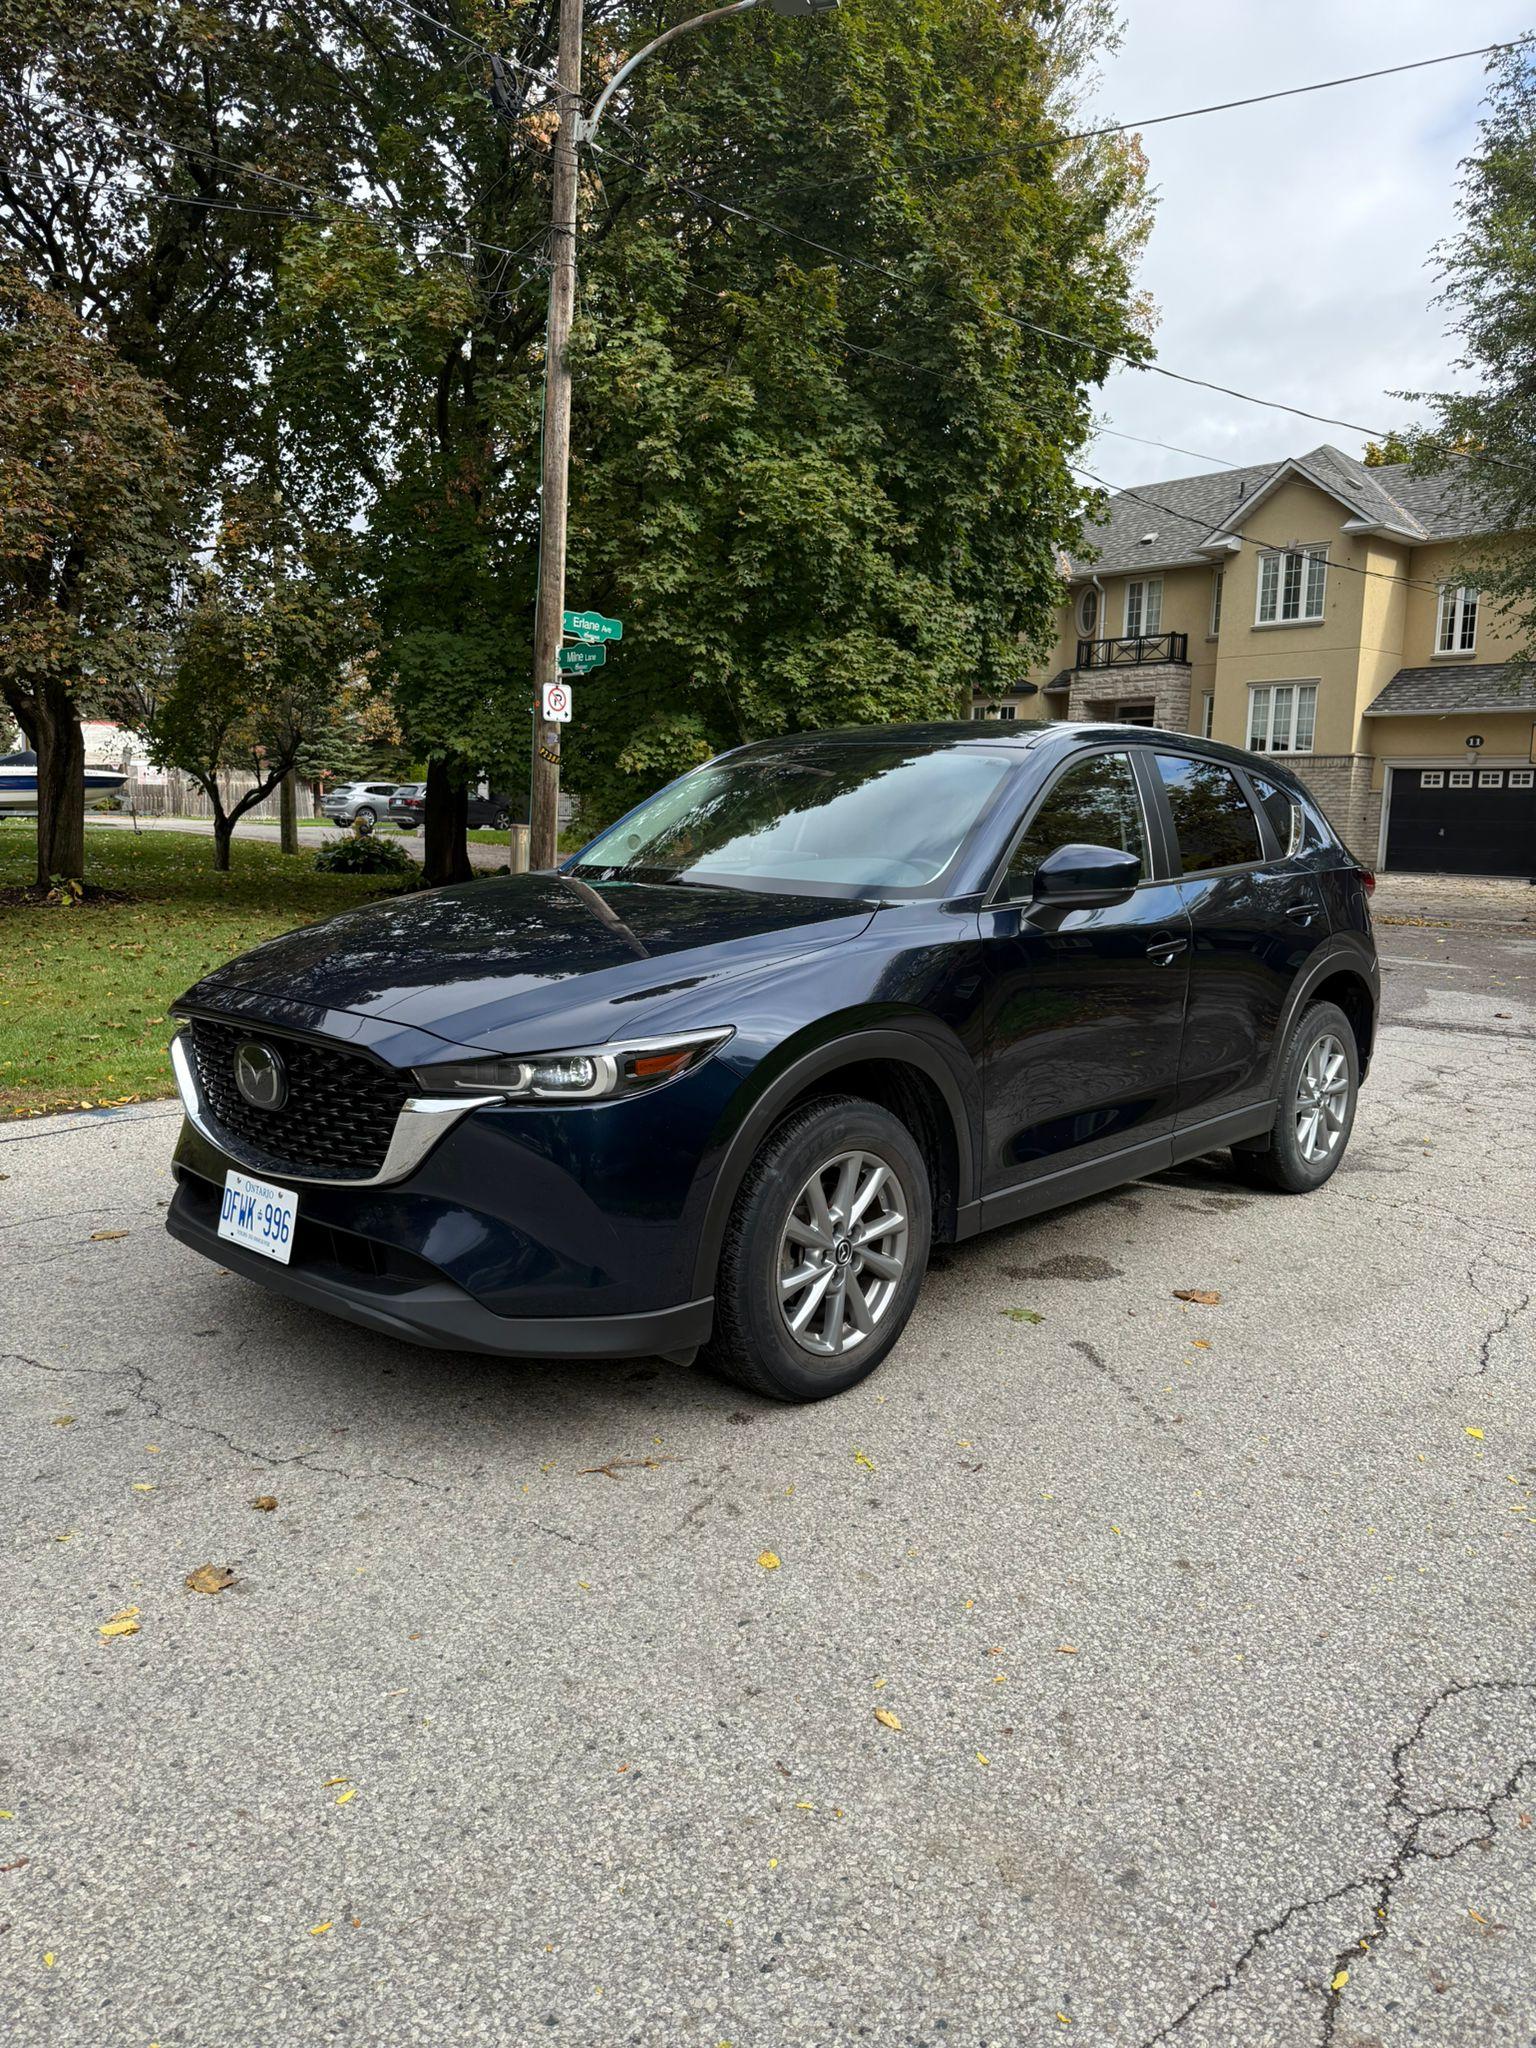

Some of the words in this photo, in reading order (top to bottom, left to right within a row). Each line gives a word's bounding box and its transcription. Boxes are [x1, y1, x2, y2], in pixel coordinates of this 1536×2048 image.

[573, 616, 600, 631] Erlane
[601, 625, 613, 634] Ave
[1469, 738, 1480, 746] 11
[246, 1181, 274, 1199] ONTARIO
[222, 1188, 257, 1230] DFWK
[263, 1204, 291, 1243] 996
